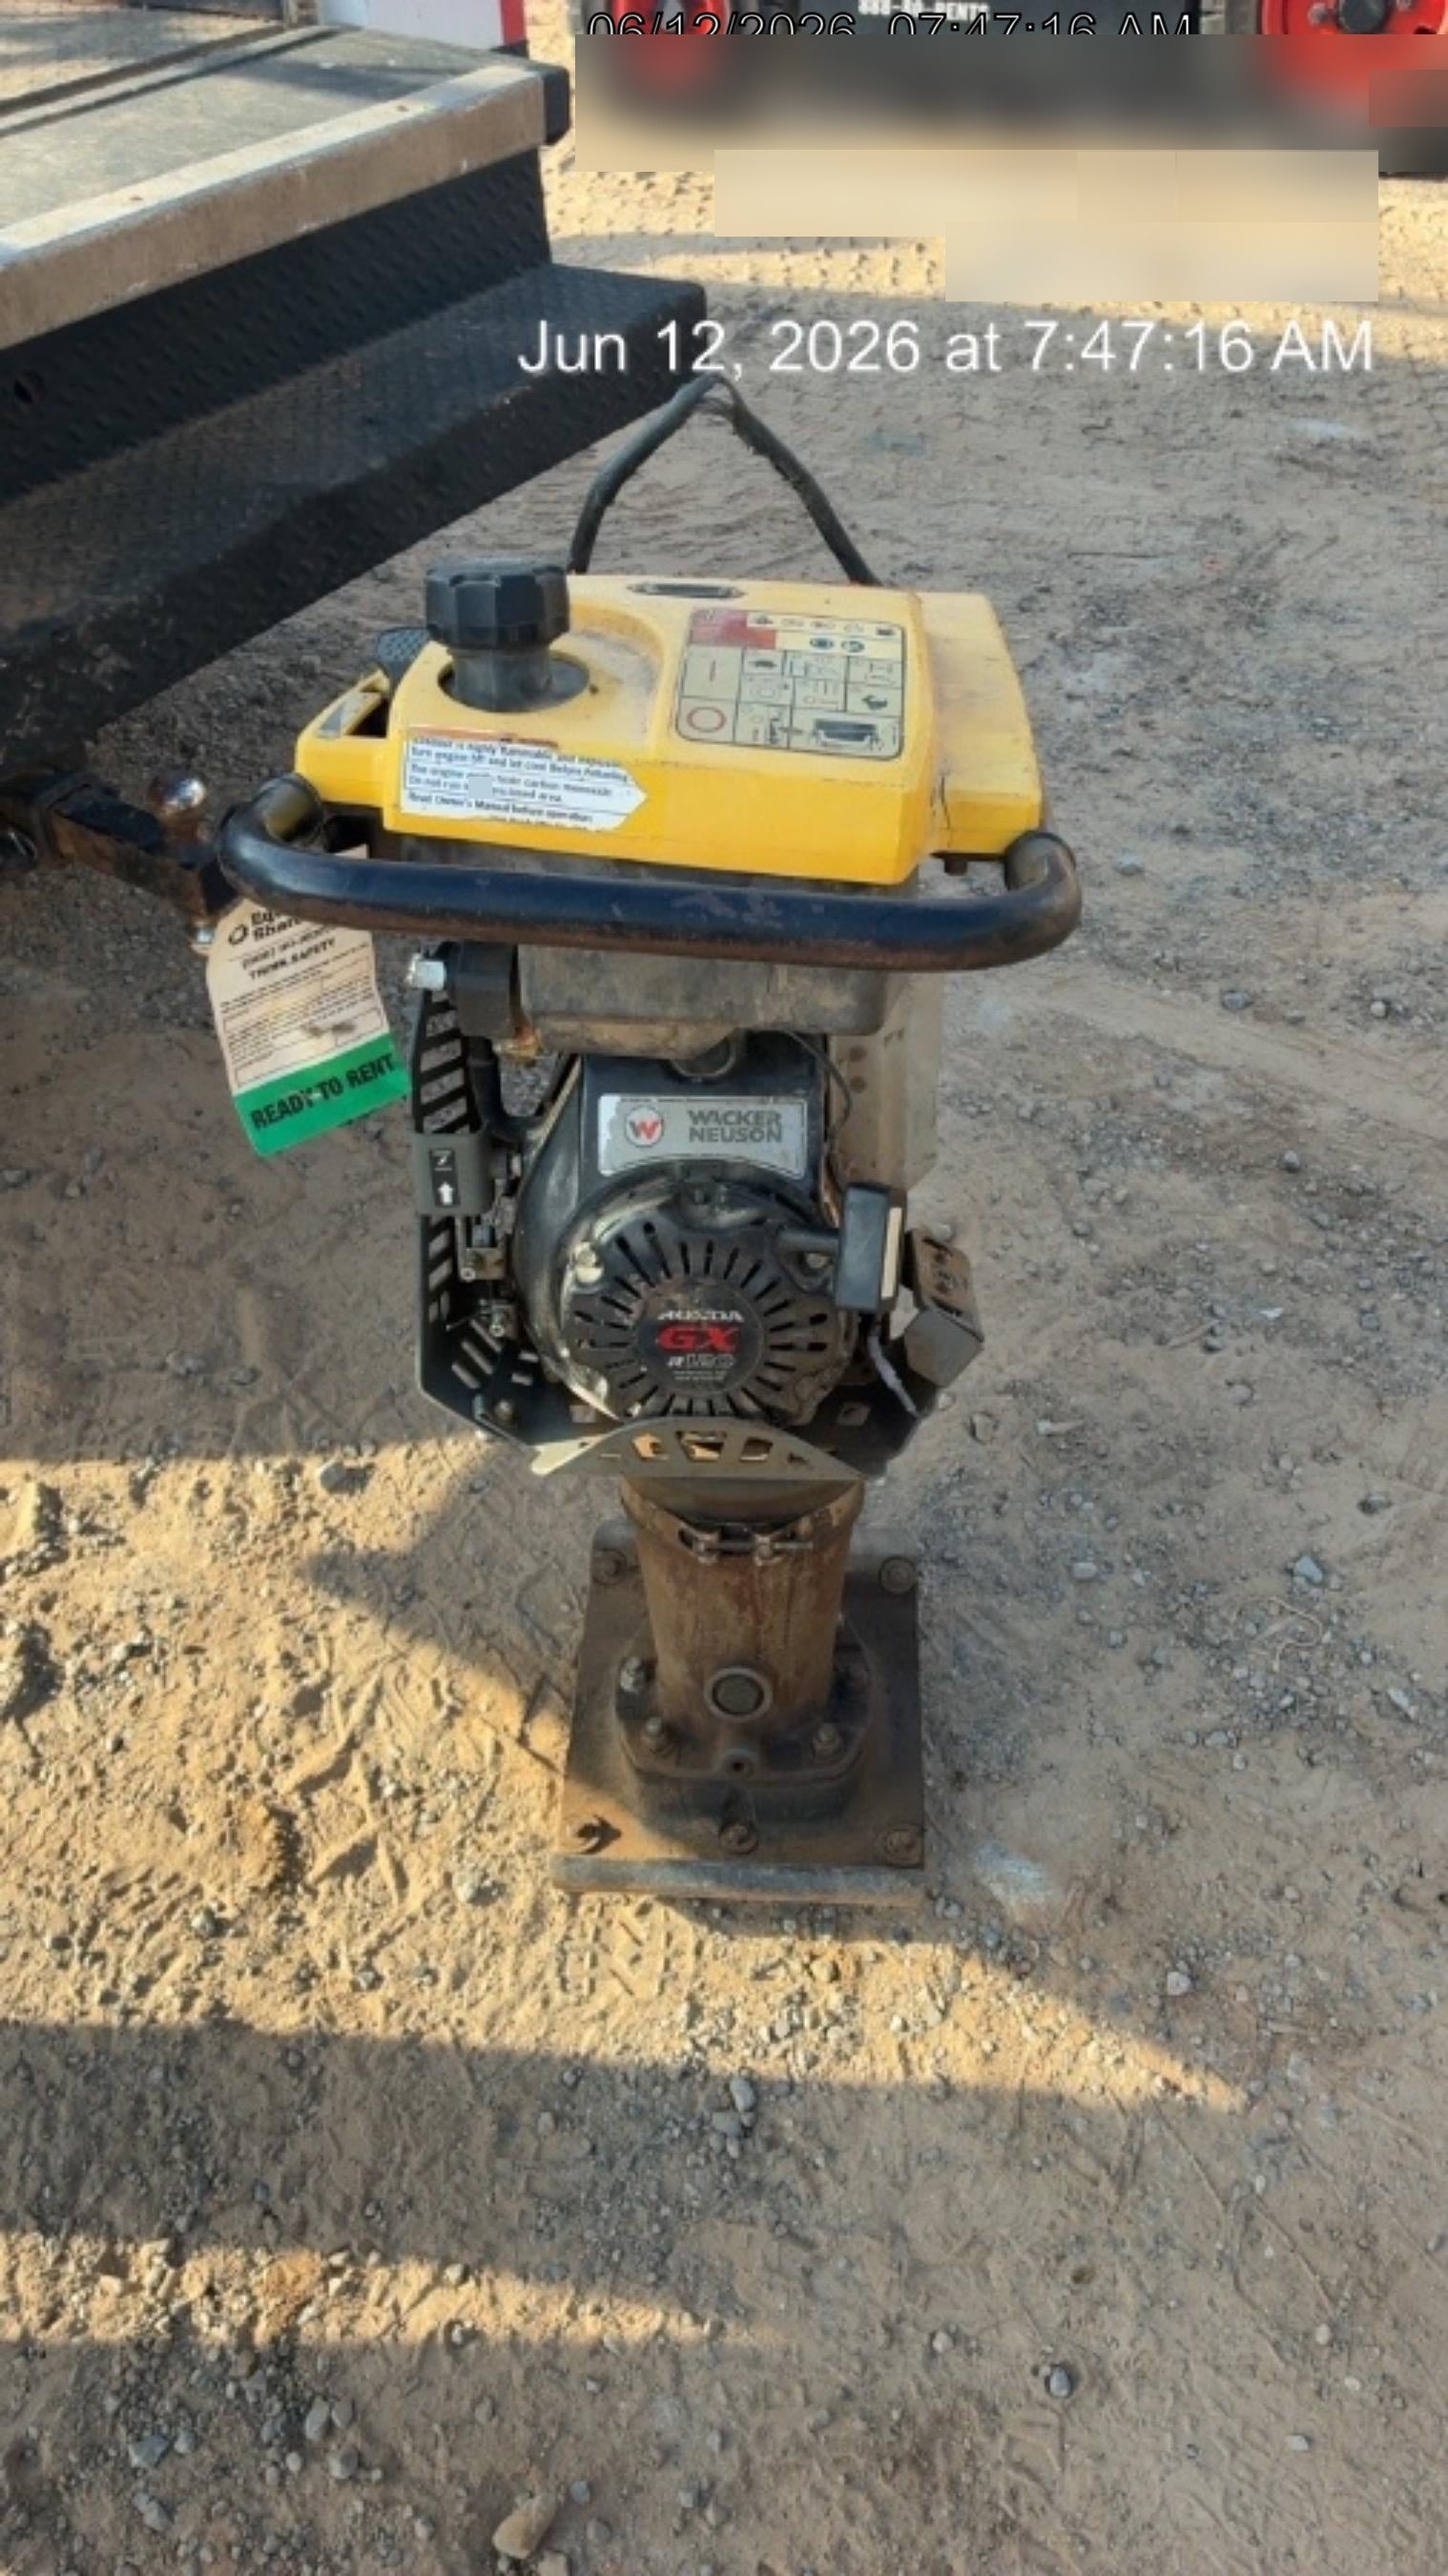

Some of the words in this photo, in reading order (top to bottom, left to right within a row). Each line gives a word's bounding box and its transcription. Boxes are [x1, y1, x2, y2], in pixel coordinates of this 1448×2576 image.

[250, 1086, 315, 1130] READY
[314, 1074, 344, 1101] TO
[345, 1052, 397, 1089] RENT
[689, 1127, 783, 1143] NEUSON
